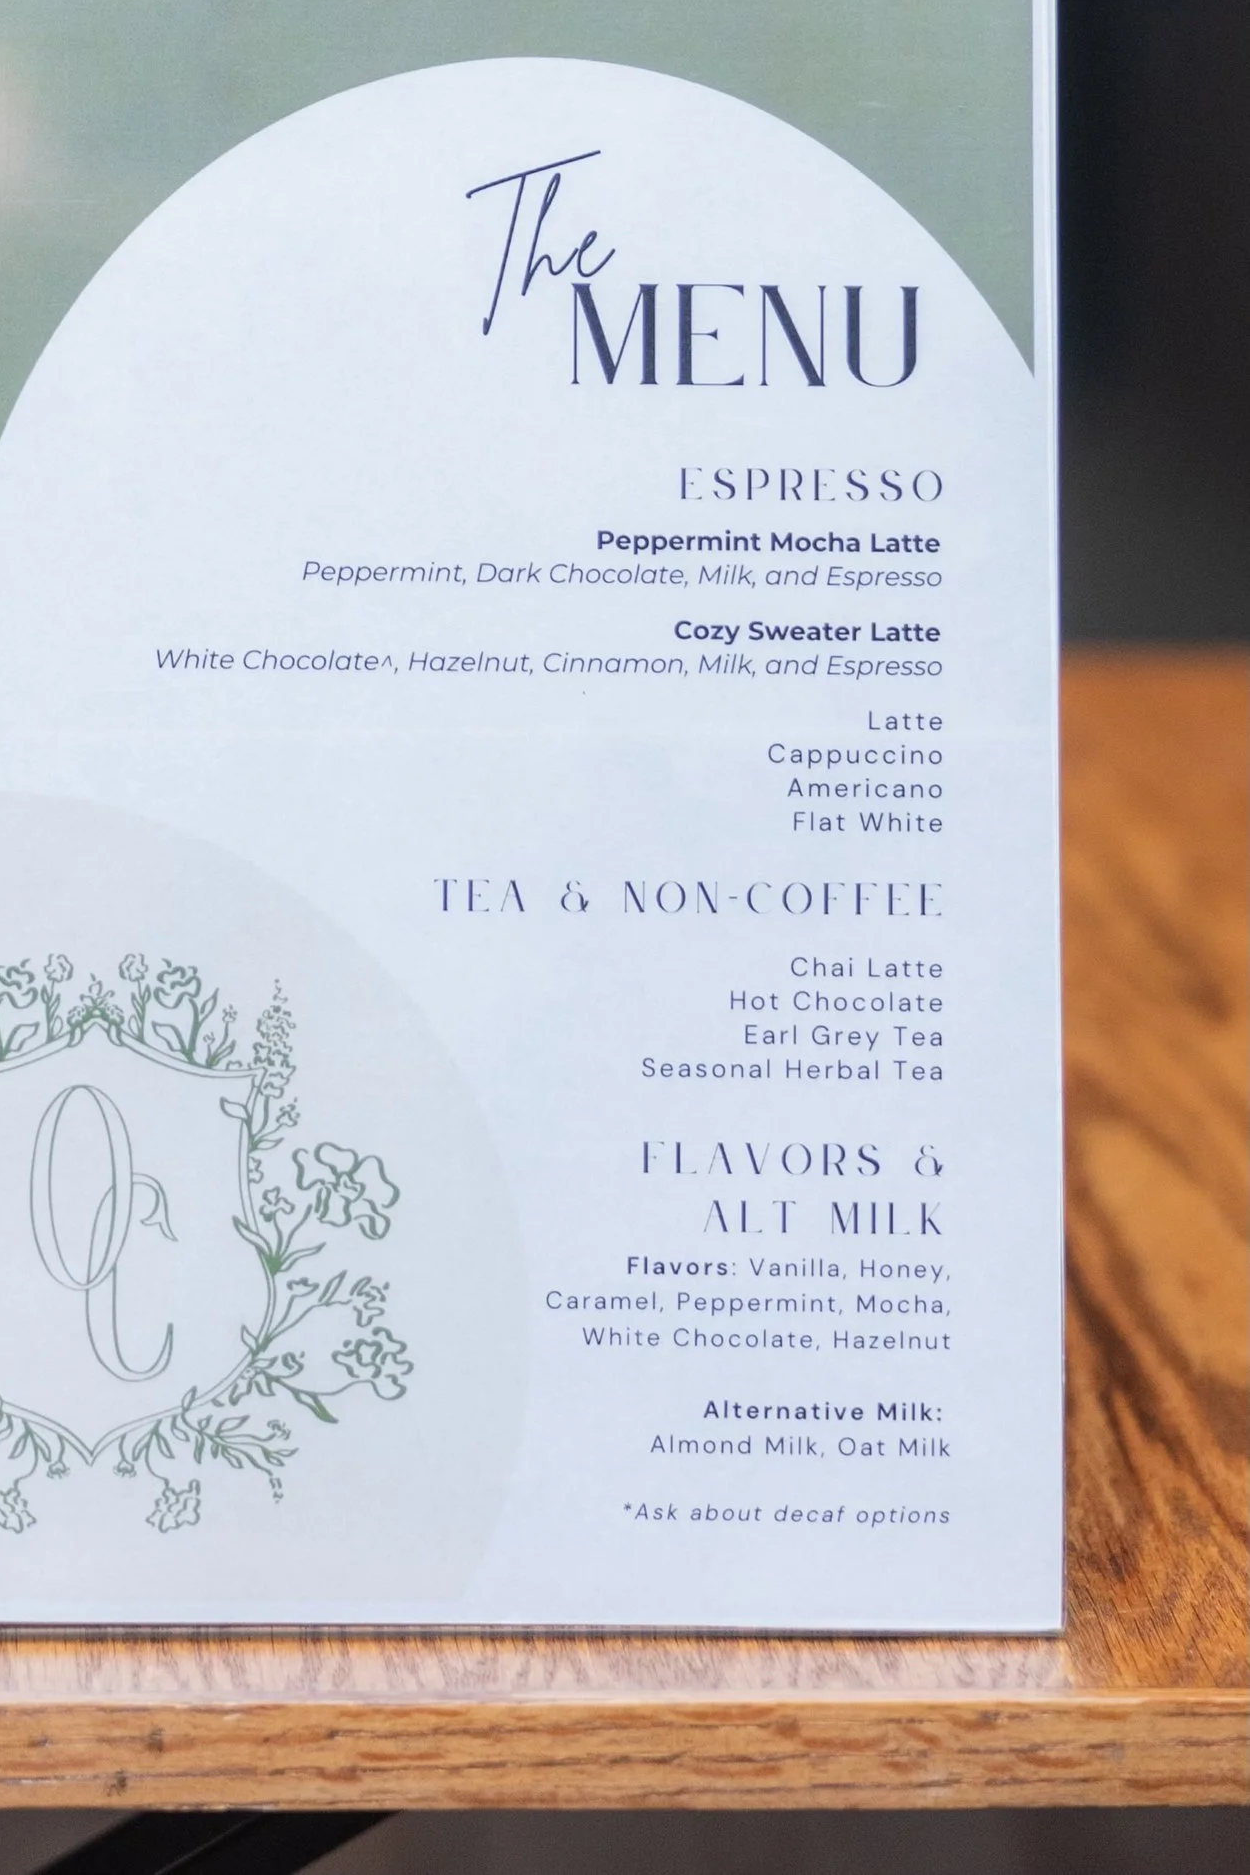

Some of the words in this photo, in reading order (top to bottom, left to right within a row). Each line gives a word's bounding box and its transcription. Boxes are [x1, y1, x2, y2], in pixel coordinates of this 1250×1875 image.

[465, 149, 616, 336] The
[570, 282, 920, 388] MENU
[681, 467, 943, 502] ESPRESSO
[597, 529, 761, 556] Peppermint
[770, 531, 861, 554] Mocha
[871, 533, 941, 553] Latte
[302, 561, 466, 587] Peppermint,
[476, 561, 542, 584] Dark
[550, 562, 689, 589] Chocolate,
[698, 564, 756, 589] Milk,
[765, 565, 819, 586] and
[826, 566, 942, 591] Espresso
[674, 620, 741, 646] Cozy
[748, 621, 862, 642] Sweater
[871, 622, 941, 645] Latte
[156, 648, 235, 670] White
[408, 651, 533, 676] Hazelnut,
[543, 652, 688, 677] Cinnamon,
[698, 653, 756, 679] Milk,
[765, 654, 819, 676] and
[827, 655, 942, 681] Espresso
[868, 710, 943, 733] Latte
[768, 743, 942, 770] Cappuccino
[787, 777, 942, 800] Americano
[793, 811, 846, 832] Flat
[859, 811, 942, 833] White
[434, 879, 525, 912] TEA
[560, 880, 589, 913] &
[624, 880, 942, 916] NON-COFFEE
[791, 957, 854, 978] Chai
[868, 957, 942, 980] Latte
[730, 990, 779, 1013] Hot
[793, 990, 943, 1013] Chocolate
[745, 1024, 797, 1045] Earl
[811, 1025, 880, 1052] Grey
[893, 1026, 942, 1047] Tea
[642, 1057, 770, 1079] Seasonal
[786, 1058, 879, 1081] Herbal
[893, 1060, 942, 1081] Tea
[643, 1141, 880, 1176] FLAVORS
[914, 1145, 944, 1177] &
[703, 1200, 796, 1234] ALT
[831, 1201, 942, 1236] MILK
[627, 1255, 736, 1277] Flavors:
[749, 1257, 846, 1281] Vanilla,
[860, 1259, 950, 1284] Honey,
[546, 1290, 664, 1313] Caramel,
[677, 1292, 843, 1317] Peppermint,
[857, 1294, 950, 1317] Mocha,
[582, 1326, 662, 1347] White
[673, 1327, 820, 1351] Chocolate,
[834, 1330, 950, 1350] Hazelnut
[703, 1399, 864, 1421] Alternative
[877, 1402, 942, 1423] Milk:
[650, 1434, 751, 1455] Almond
[766, 1435, 825, 1459] Milk,
[838, 1437, 886, 1456] Oat
[899, 1437, 950, 1457] Milk
[690, 1503, 762, 1522] about
[774, 1504, 845, 1524] decaf
[856, 1506, 950, 1528] options
